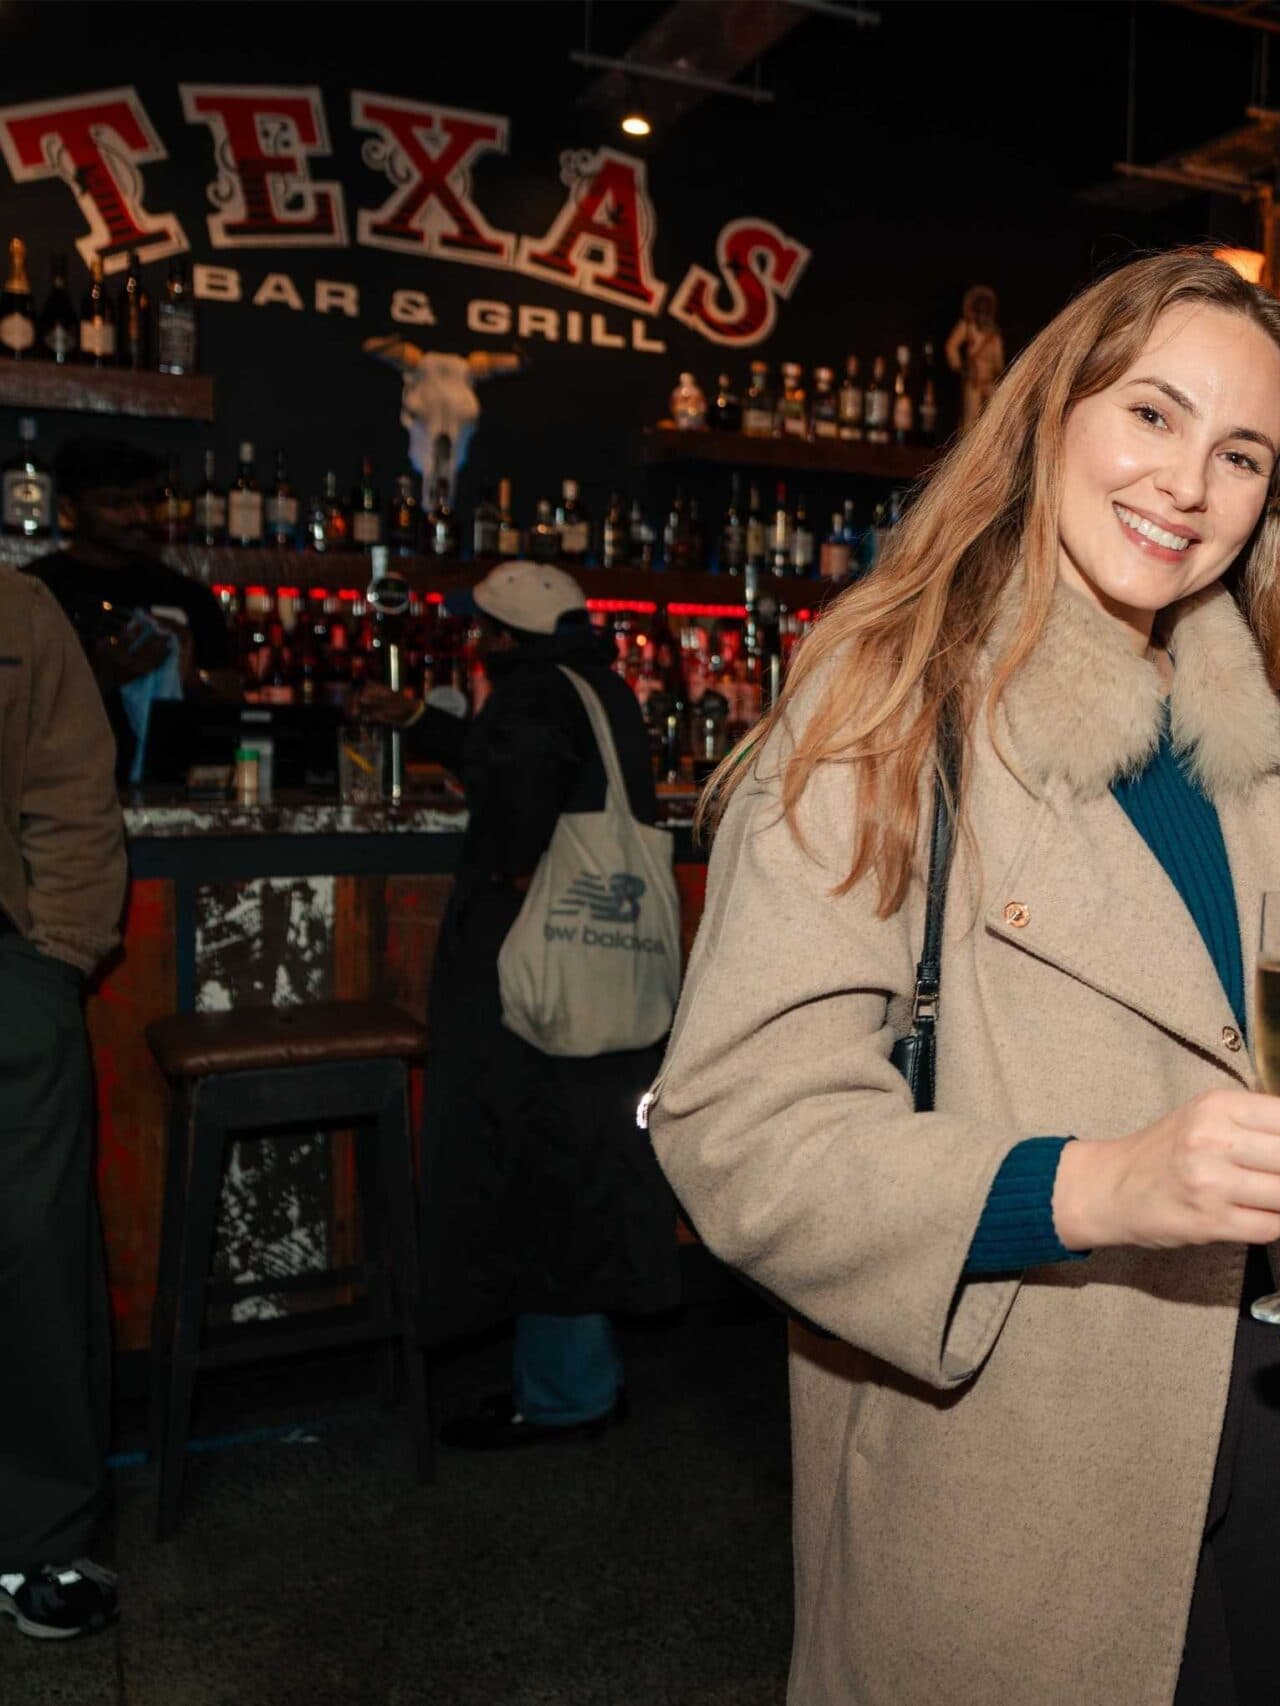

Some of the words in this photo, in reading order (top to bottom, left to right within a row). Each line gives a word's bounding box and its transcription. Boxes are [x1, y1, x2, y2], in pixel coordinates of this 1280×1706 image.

[0, 84, 811, 348] TEXAS
[193, 263, 361, 318] BAR
[391, 289, 437, 326] &
[466, 299, 667, 354] GRILL
